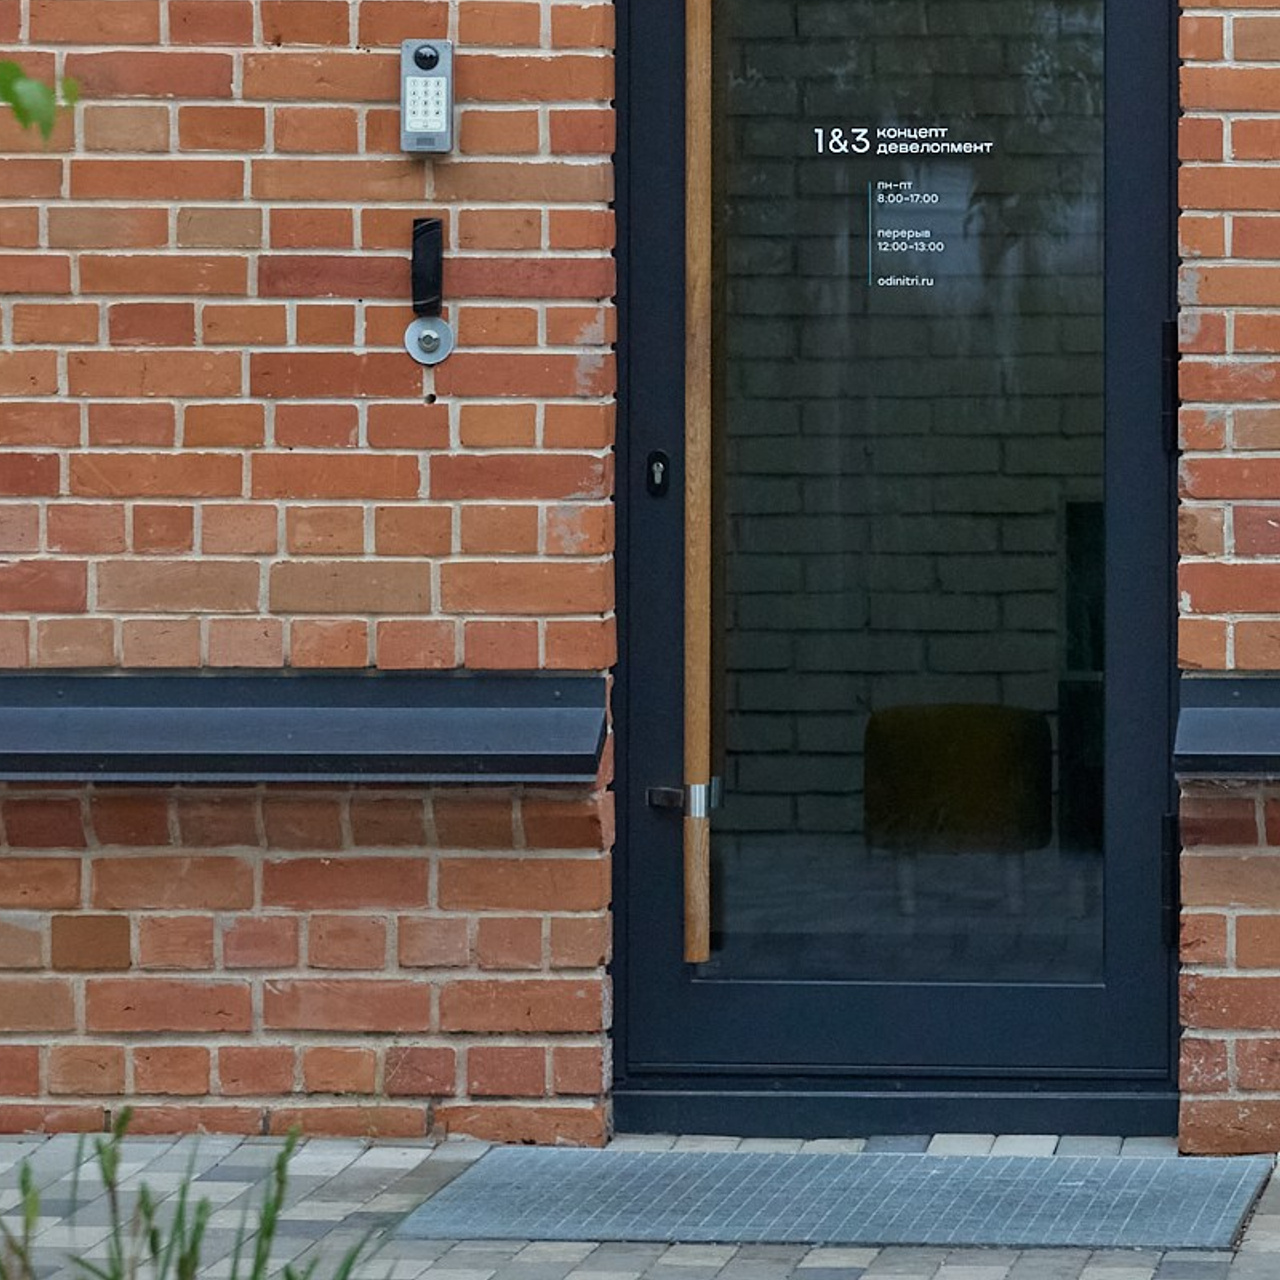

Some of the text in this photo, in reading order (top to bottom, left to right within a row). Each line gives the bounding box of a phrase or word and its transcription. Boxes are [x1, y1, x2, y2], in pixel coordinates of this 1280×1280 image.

[876, 127, 949, 140] концепт
[814, 127, 870, 154] 1&3
[876, 142, 994, 155] девелопмент
[877, 229, 931, 241] перерыв
[877, 275, 934, 287] odinitri.ru
